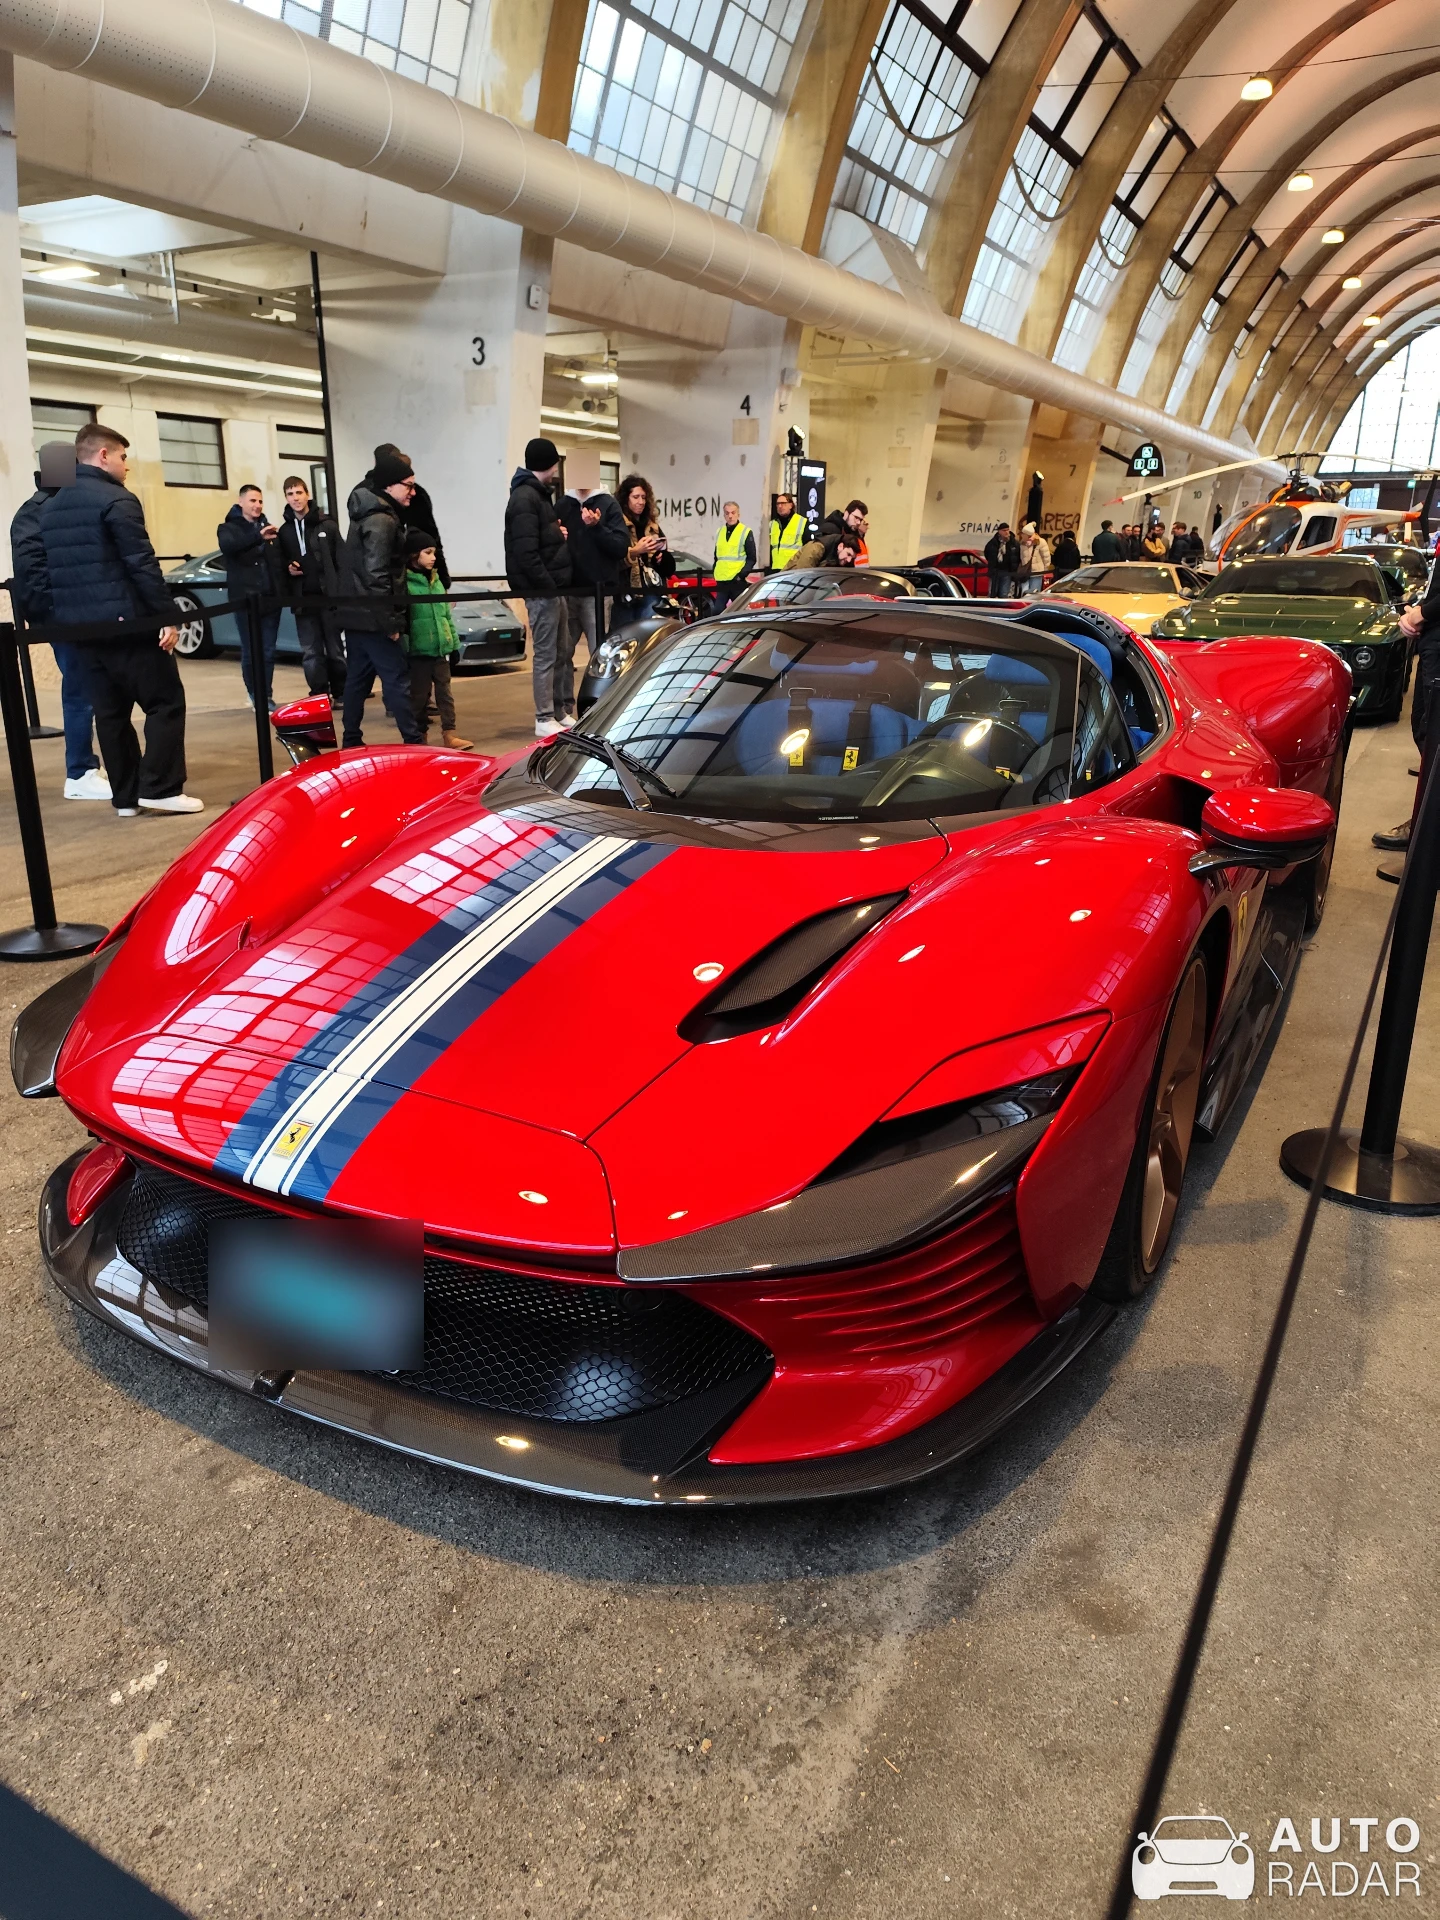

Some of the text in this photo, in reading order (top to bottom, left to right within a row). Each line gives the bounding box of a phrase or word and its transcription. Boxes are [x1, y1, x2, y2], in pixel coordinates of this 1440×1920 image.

[472, 337, 485, 365] 3
[740, 395, 751, 416] 4
[1069, 464, 1077, 476] 7
[1193, 490, 1202, 499] 10
[655, 493, 721, 518] SIMEON
